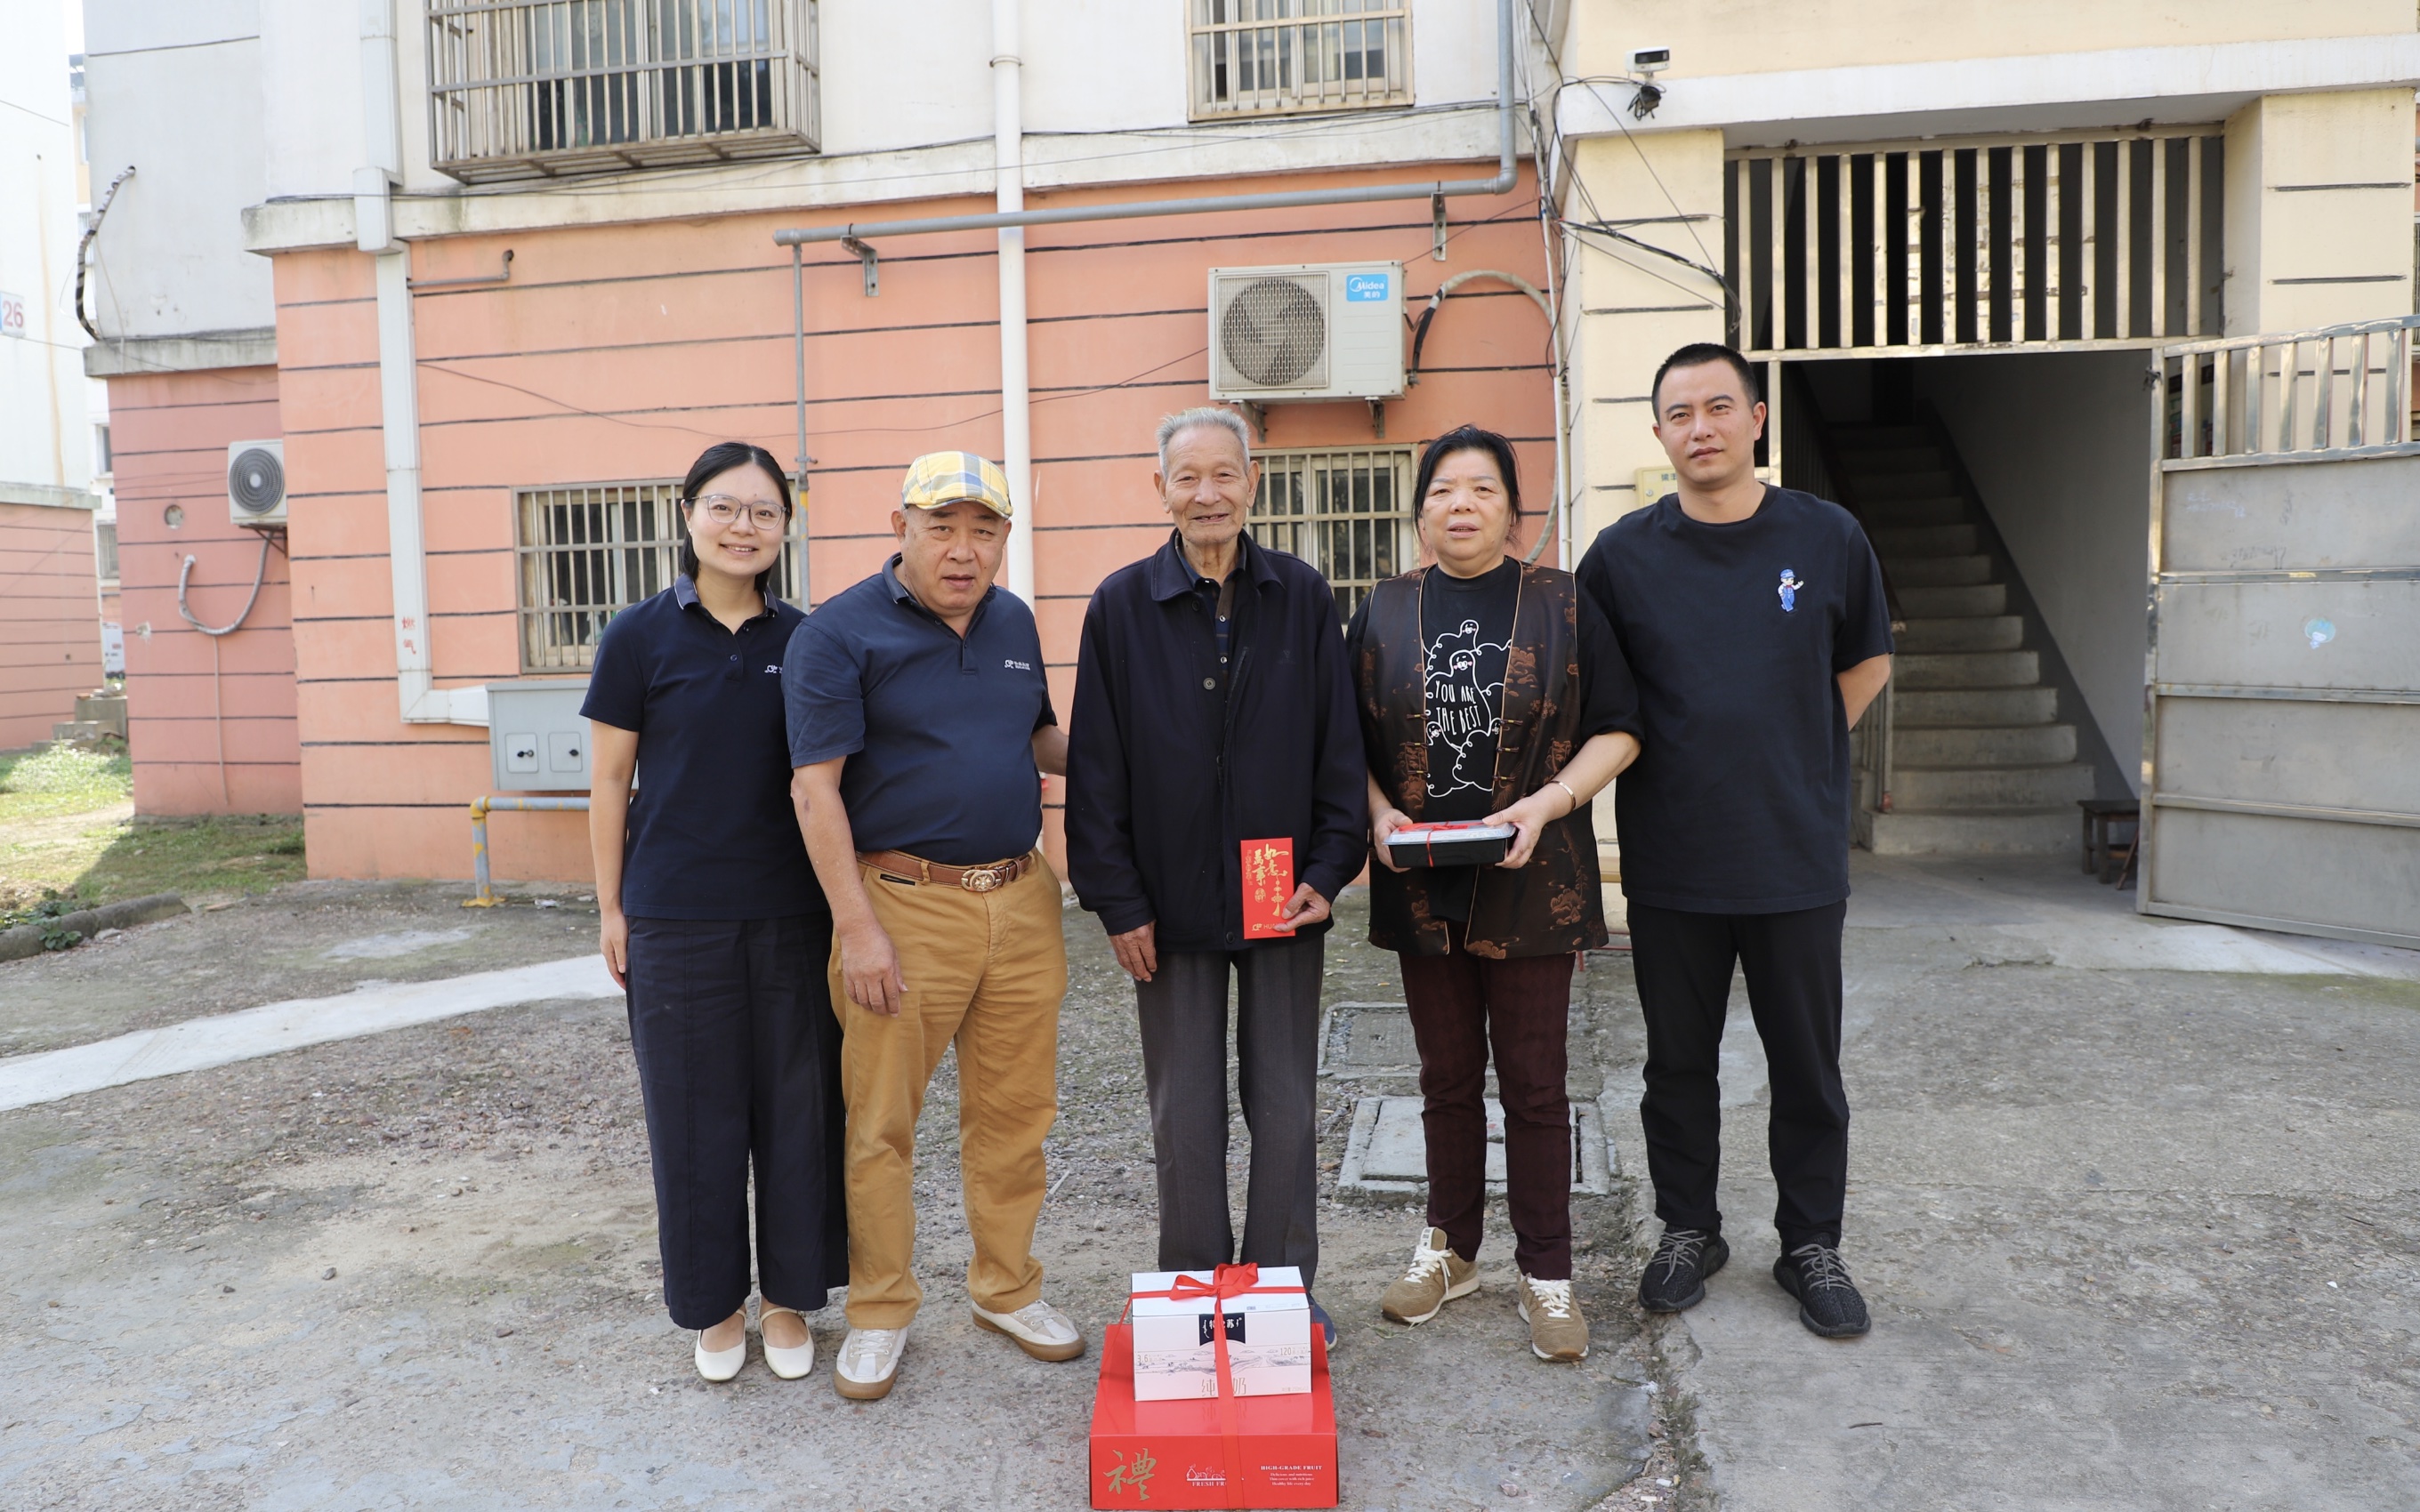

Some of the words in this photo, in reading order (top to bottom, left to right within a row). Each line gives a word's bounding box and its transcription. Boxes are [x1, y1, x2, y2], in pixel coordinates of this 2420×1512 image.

[1350, 277, 1385, 293] Midea
[3, 300, 24, 329] 26
[1435, 680, 1456, 703] YOU
[1461, 685, 1477, 704] ARE
[1435, 706, 1457, 736] THE
[1458, 704, 1481, 734] BEST
[1280, 1347, 1292, 1356] 120
[1201, 1378, 1246, 1397] 纯奶
[1102, 1447, 1157, 1501] 禮
